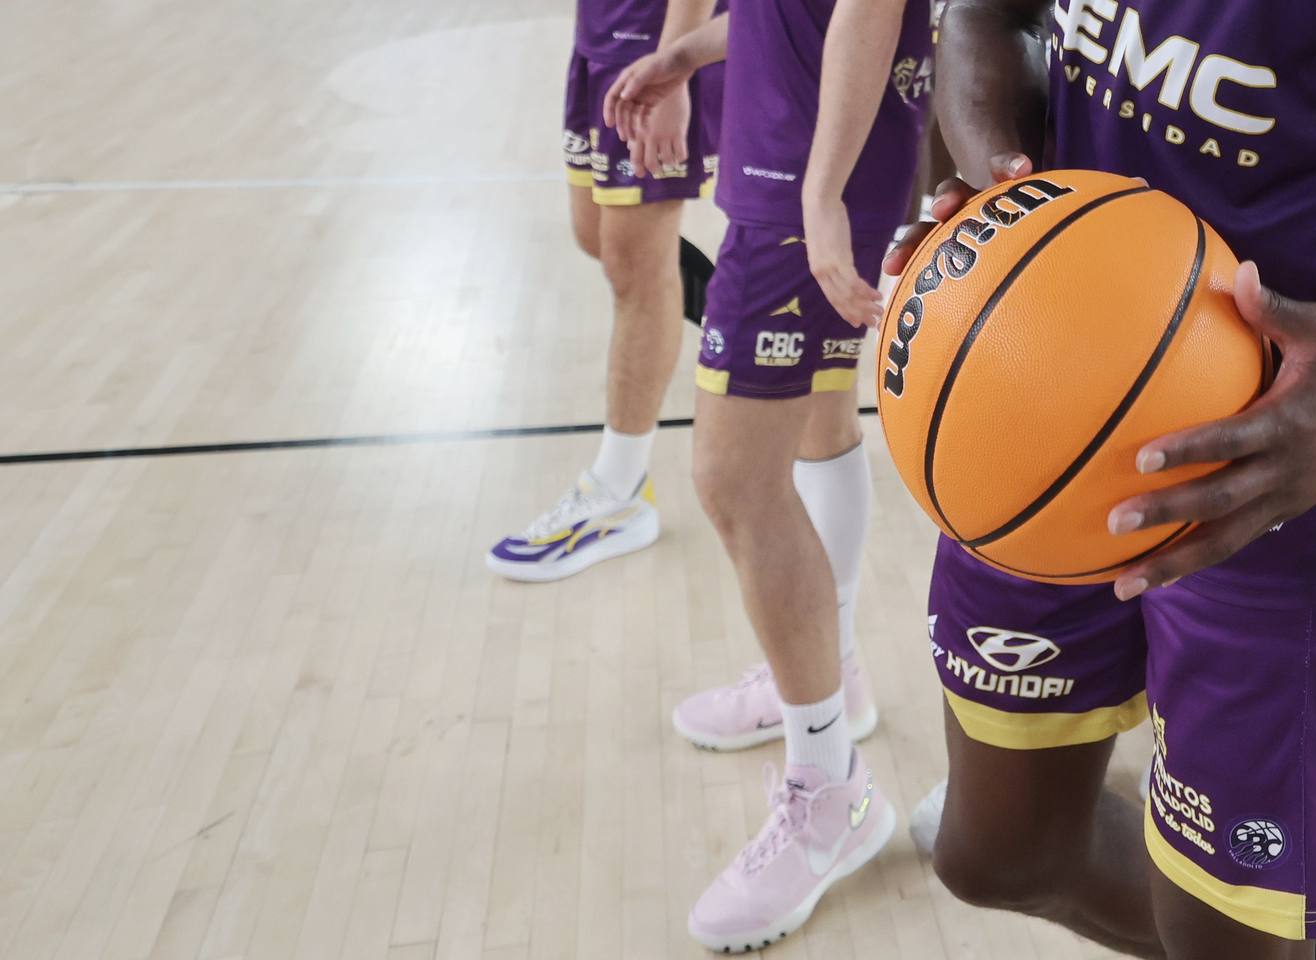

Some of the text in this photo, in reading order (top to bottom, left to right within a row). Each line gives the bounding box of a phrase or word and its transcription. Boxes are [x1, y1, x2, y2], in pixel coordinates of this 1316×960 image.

[884, 178, 1077, 399] Wilson
[755, 330, 805, 358] CBC
[946, 649, 1075, 699] HYUNDAI
